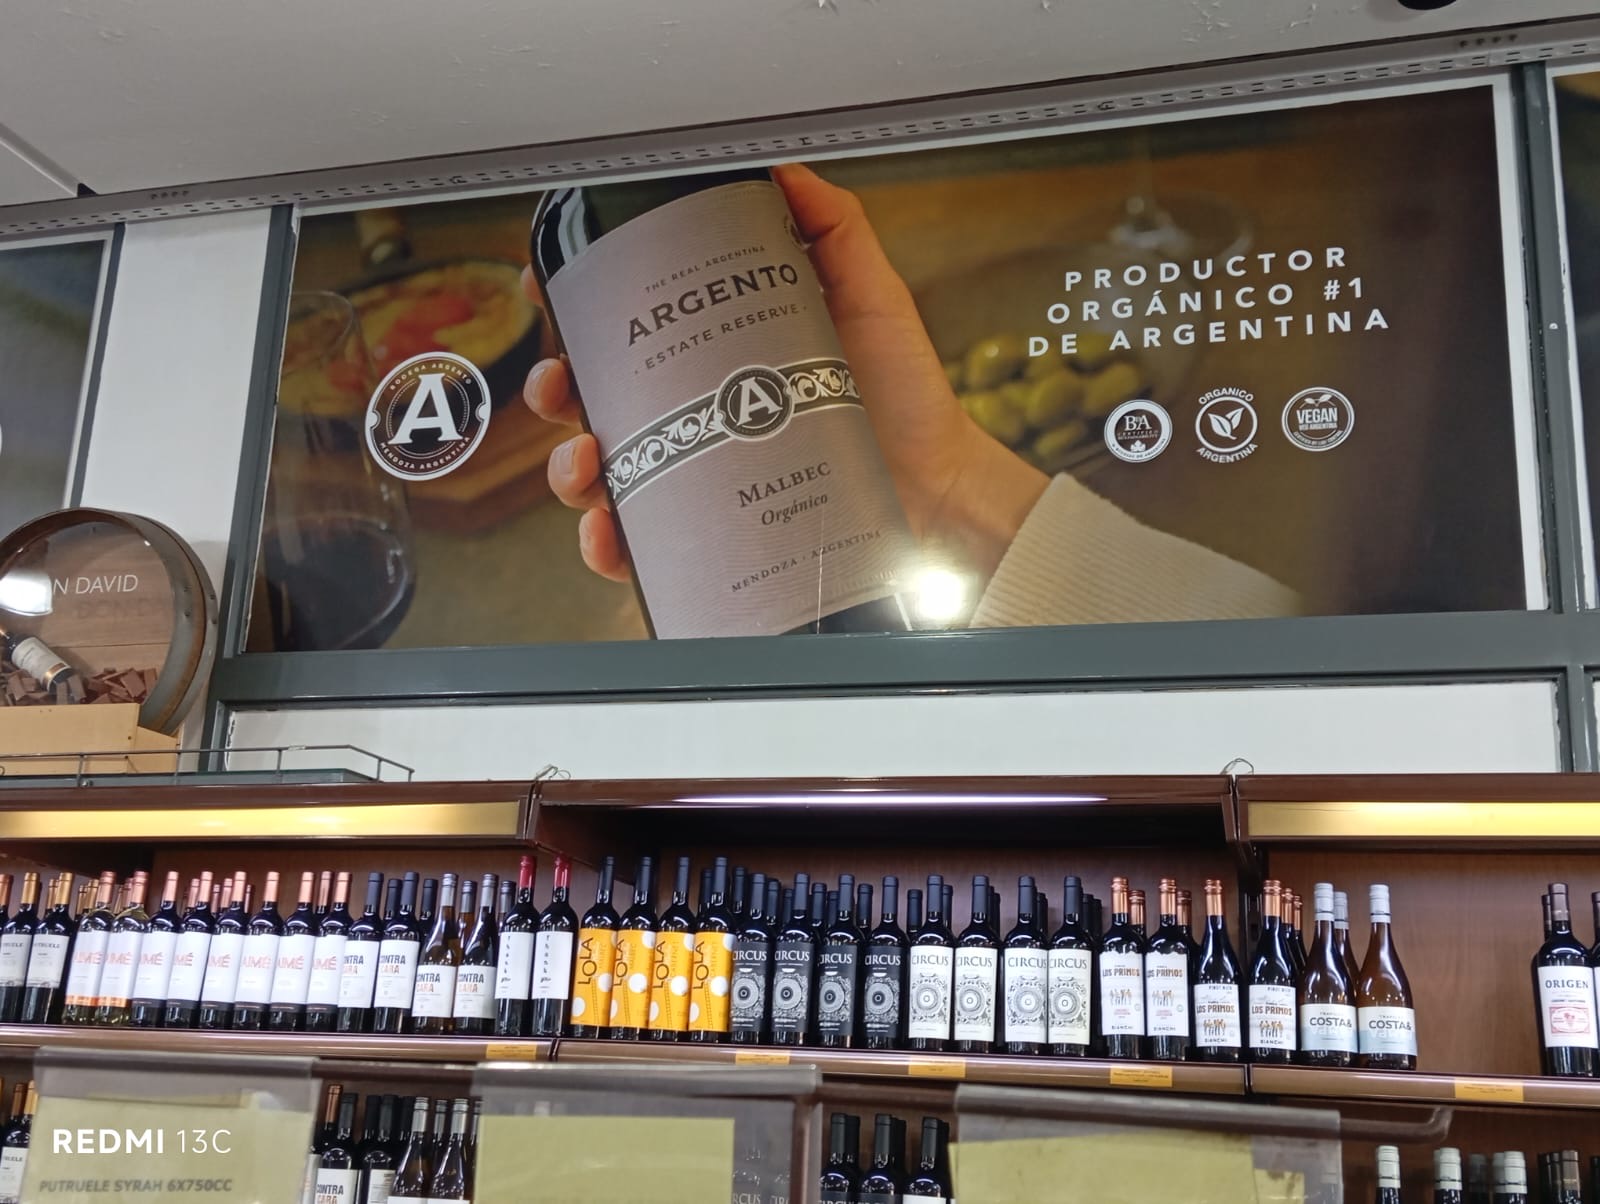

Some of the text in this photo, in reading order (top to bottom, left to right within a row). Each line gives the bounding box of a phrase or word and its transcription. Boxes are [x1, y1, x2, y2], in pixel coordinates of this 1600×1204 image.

[645, 245, 766, 294] THE REAL ARGENTINA
[1065, 246, 1346, 292] PRODUCTOR
[628, 263, 798, 346] ARGENTO
[1047, 277, 1363, 325] ORGÁNICO #1
[645, 303, 800, 370] ESTATE RESERVE
[1028, 308, 1390, 358] DE ARGENTINA
[389, 364, 427, 391] BODEGA
[1198, 386, 1255, 405] ORGANICO
[387, 373, 464, 445] A
[736, 376, 784, 426] A
[1296, 407, 1338, 425] VEGAN
[380, 436, 471, 471] MENDOZA ARGENTINA
[1196, 443, 1258, 464] ARGENTINA
[736, 461, 833, 508] MALBEC
[760, 493, 829, 526] Orgánico
[75, 574, 139, 595] DAVID
[730, 530, 881, 593] MENDOZA ARGENTINA
[577, 937, 597, 985] LOLA
[613, 939, 628, 986] LOLA
[652, 941, 670, 989] LOLA
[693, 941, 709, 989] LOLA
[911, 954, 949, 965] CIRCUS
[1008, 956, 1047, 969] CIRCUS
[1545, 979, 1589, 989] ORIGEN
[1207, 1004, 1235, 1013] PRIMOS
[1252, 1006, 1293, 1016] LOS PRIMOS
[39, 1178, 233, 1193] PUTRUELE SYRAH 6X750CC
